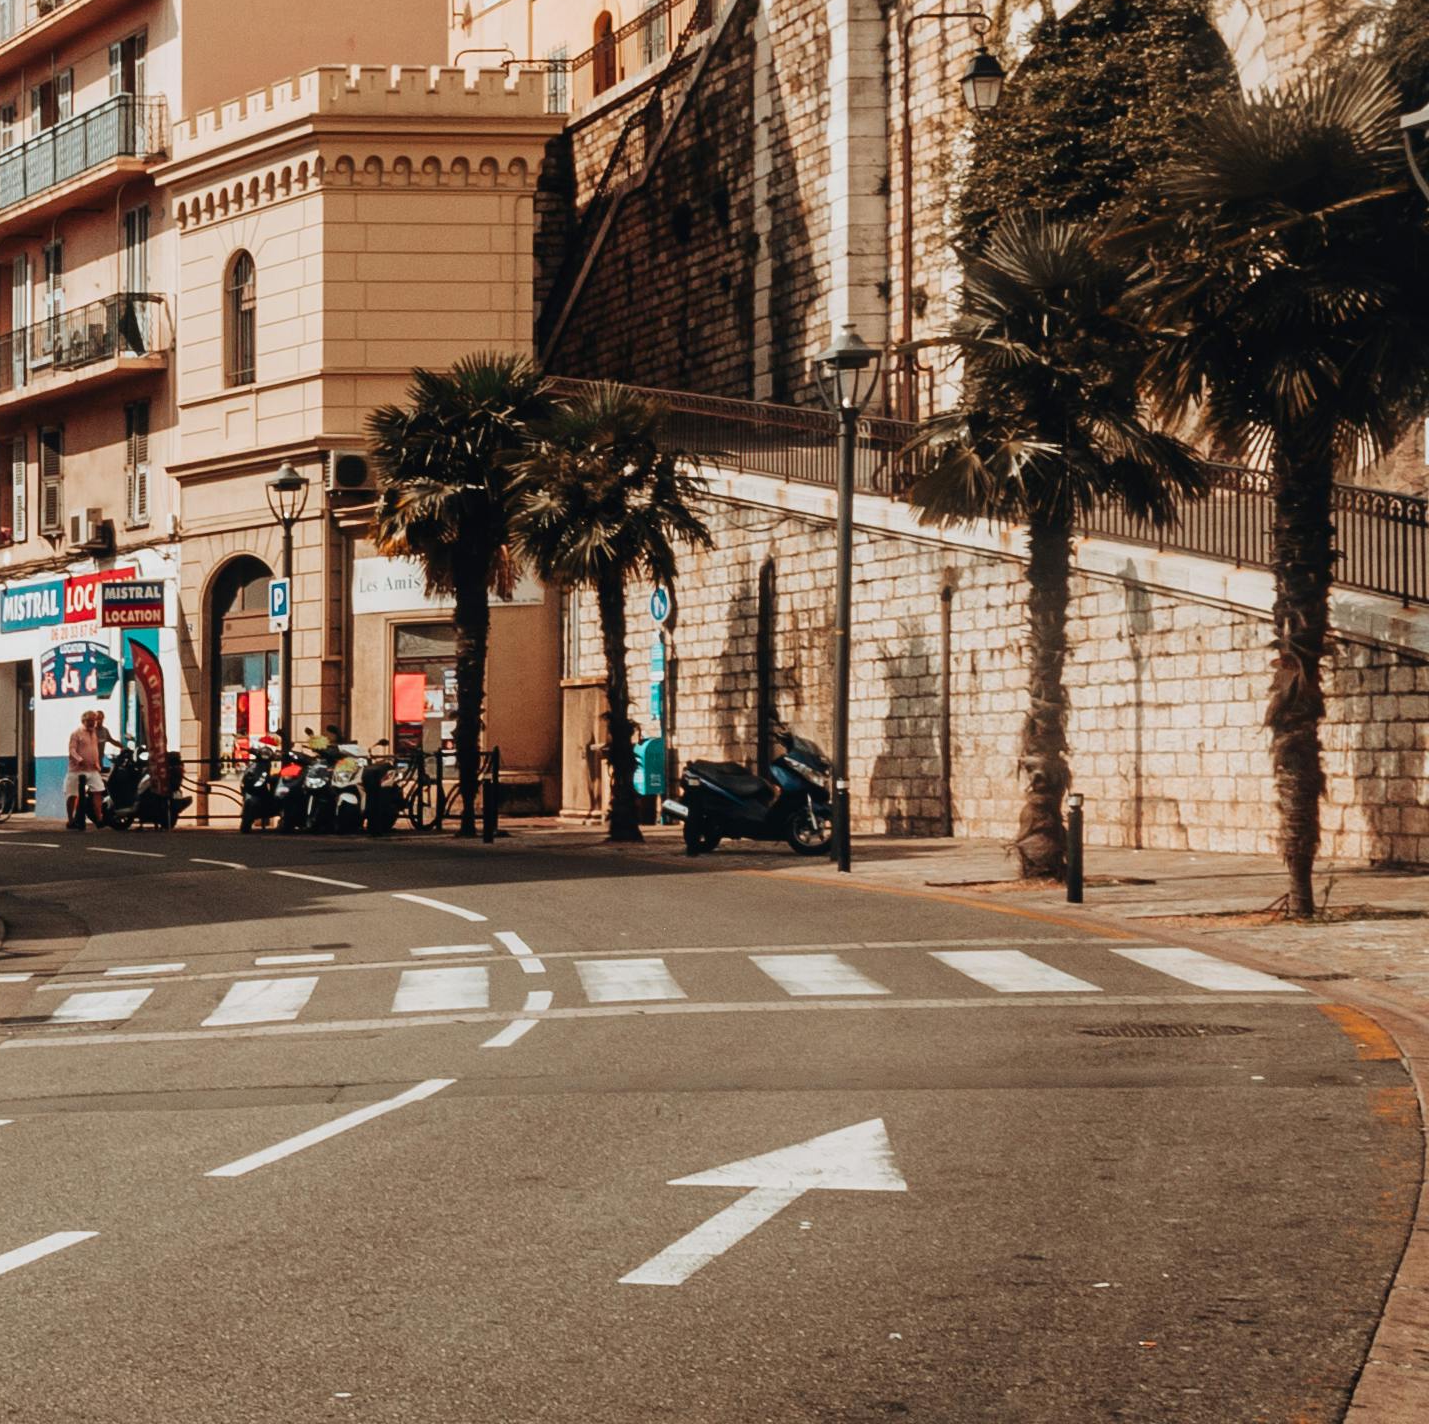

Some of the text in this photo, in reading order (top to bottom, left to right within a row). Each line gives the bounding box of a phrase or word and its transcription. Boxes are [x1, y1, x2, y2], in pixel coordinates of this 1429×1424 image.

[104, 586, 161, 600] MISTRAL
[359, 574, 422, 594] Les Amis
[3, 589, 60, 622] MISTRAL
[273, 587, 284, 612] P
[105, 609, 161, 623] LOCATION
